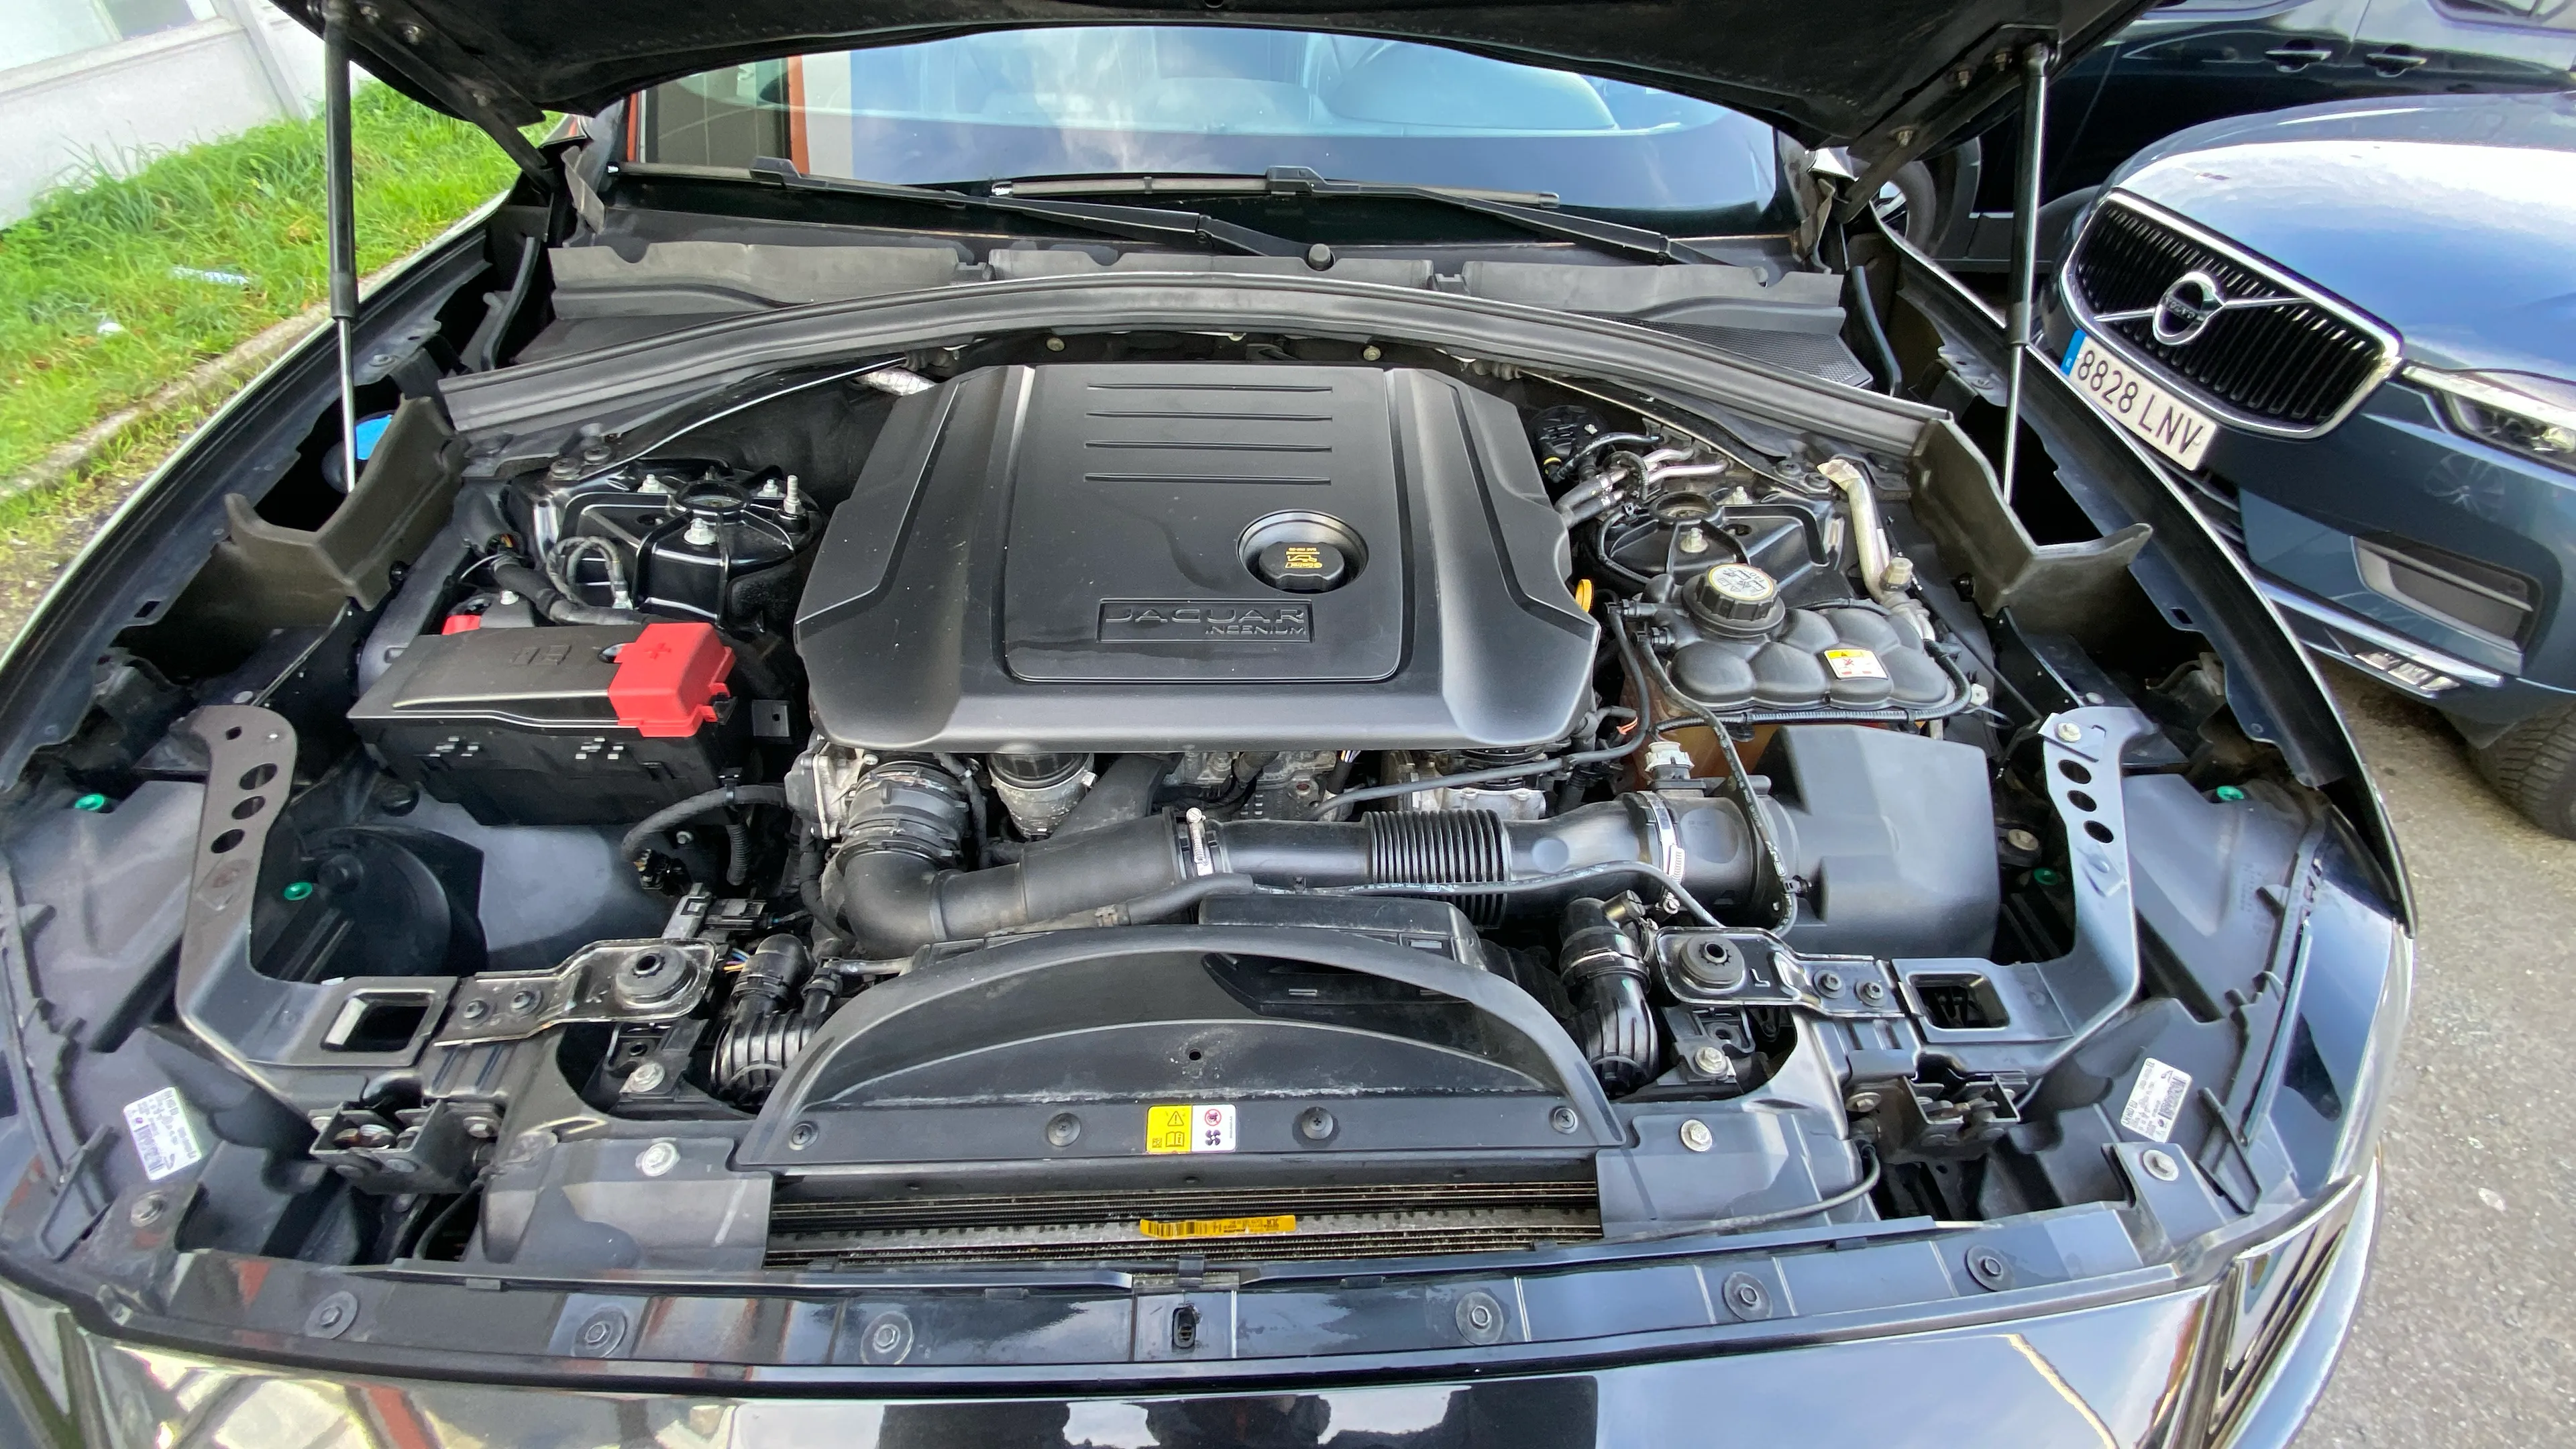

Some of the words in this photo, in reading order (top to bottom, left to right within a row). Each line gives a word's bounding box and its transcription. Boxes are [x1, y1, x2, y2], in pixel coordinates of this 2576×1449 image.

[2078, 350, 2138, 413] 8828
[2138, 394, 2204, 455] LNV
[1106, 608, 1305, 623] JAGUAR
[1205, 625, 1307, 635] INGENIUM
